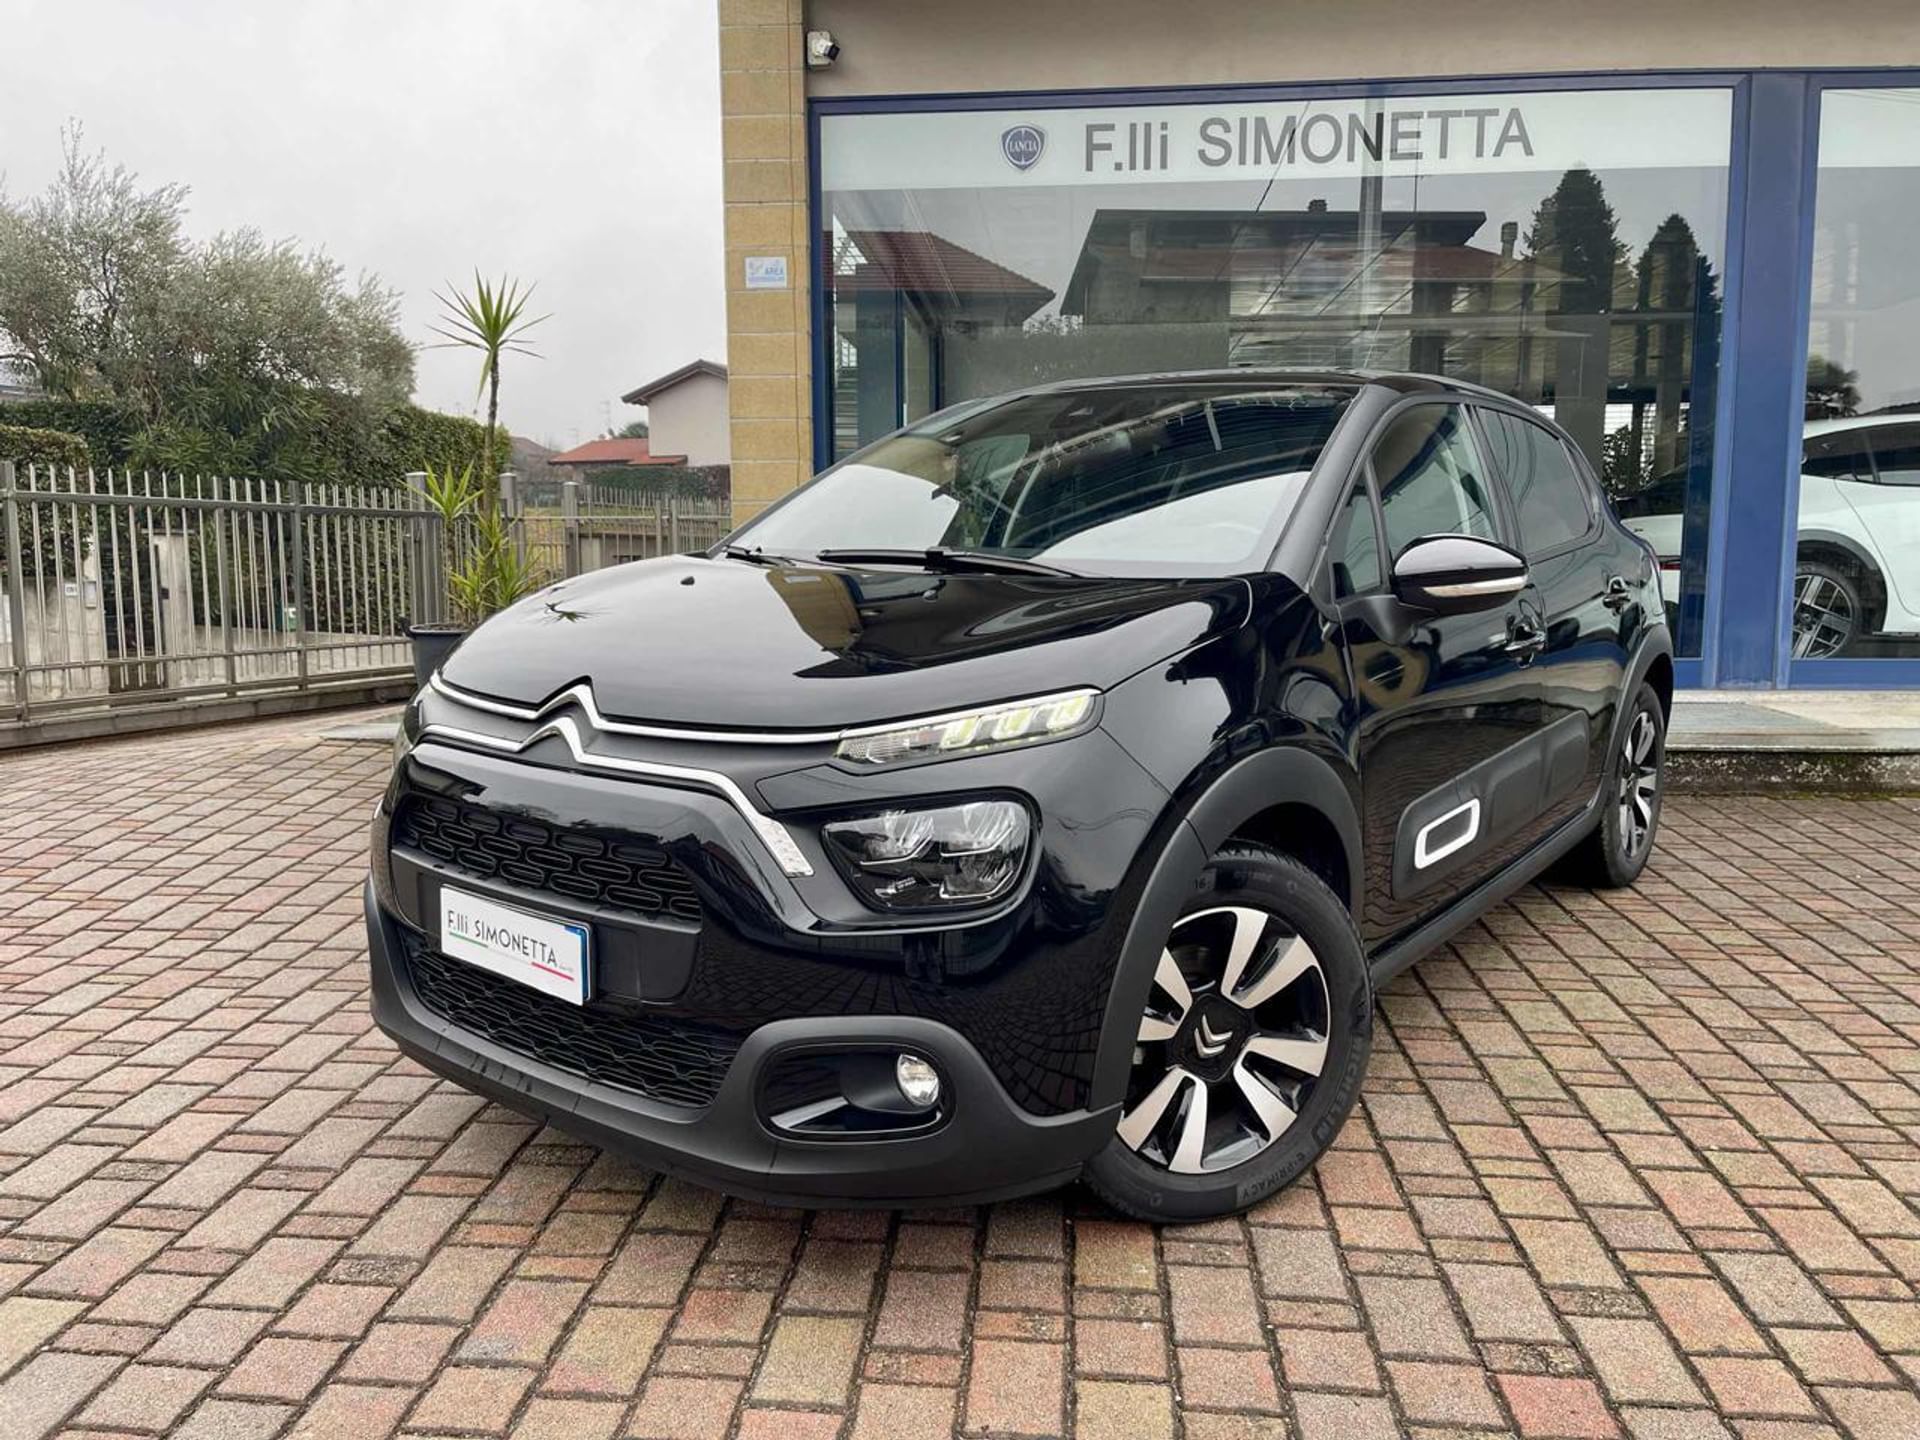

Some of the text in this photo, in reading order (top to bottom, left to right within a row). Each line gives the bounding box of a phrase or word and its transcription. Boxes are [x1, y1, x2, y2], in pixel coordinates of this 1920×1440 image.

[1009, 140, 1038, 152] LANCIA
[1198, 108, 1535, 167] SIMONETTA
[474, 919, 558, 967] SIMONETTA
